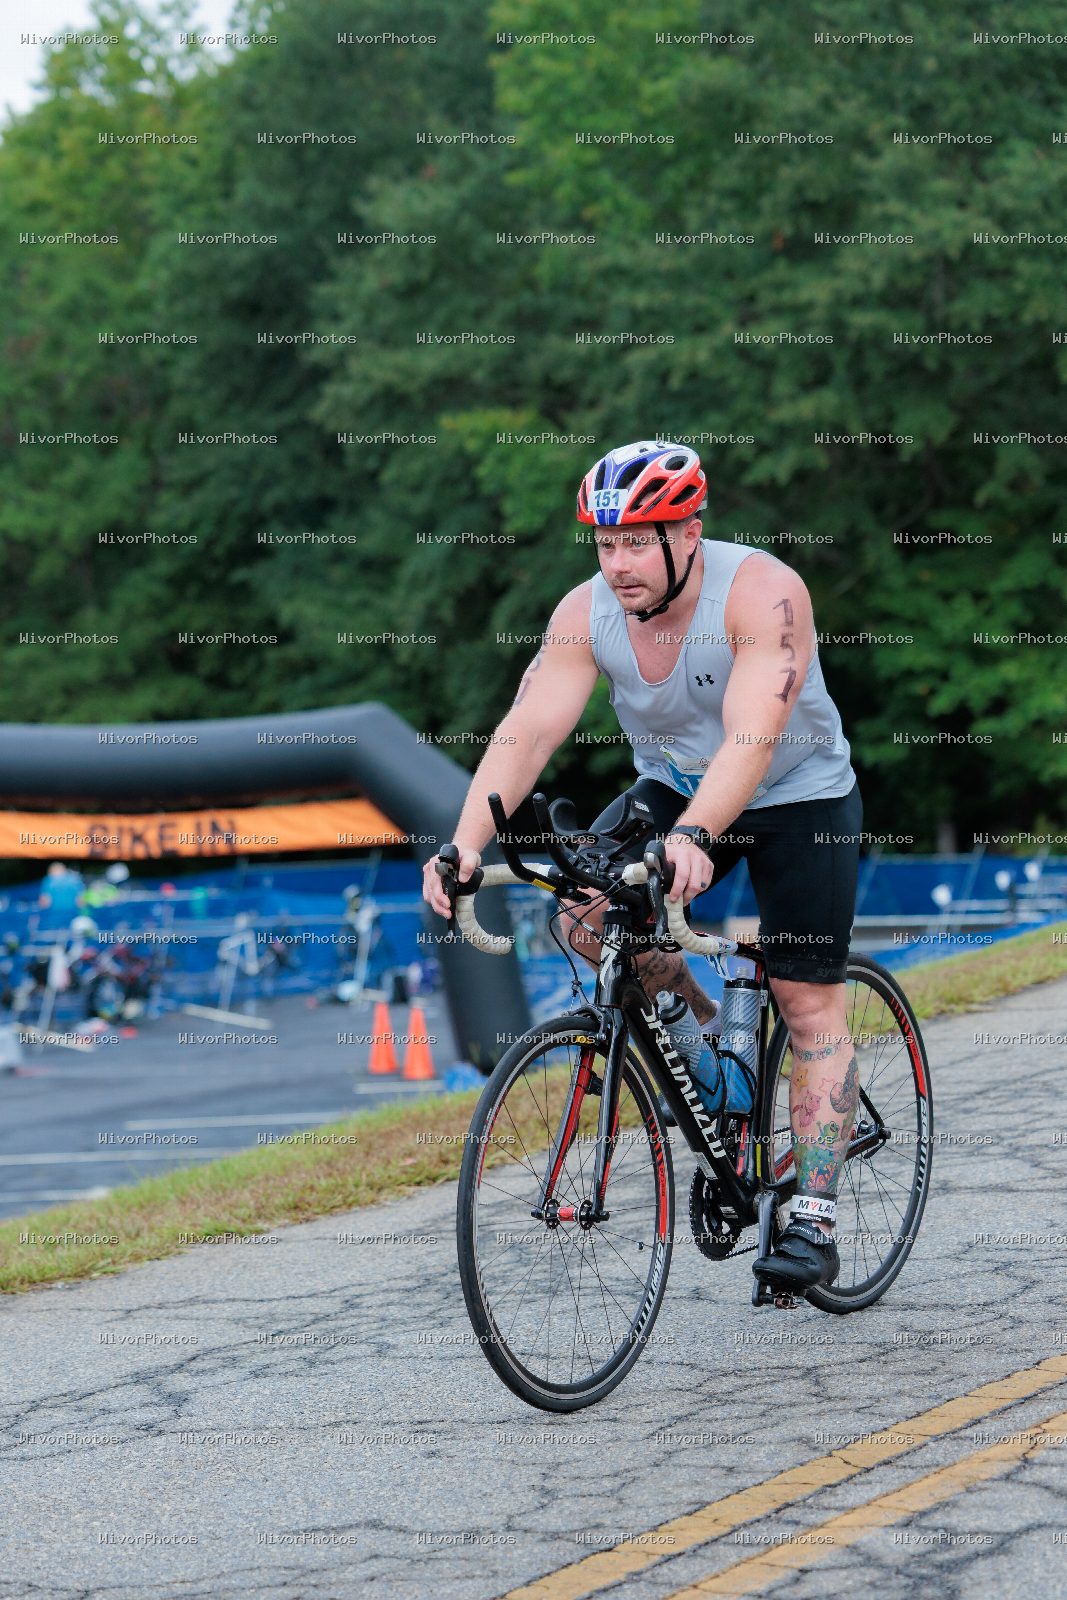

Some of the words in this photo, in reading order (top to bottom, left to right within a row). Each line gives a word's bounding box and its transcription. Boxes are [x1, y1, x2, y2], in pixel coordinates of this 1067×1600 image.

[594, 490, 620, 508] 151
[771, 598, 797, 704] 151
[88, 821, 180, 860] BIKE
[194, 815, 236, 857] IN
